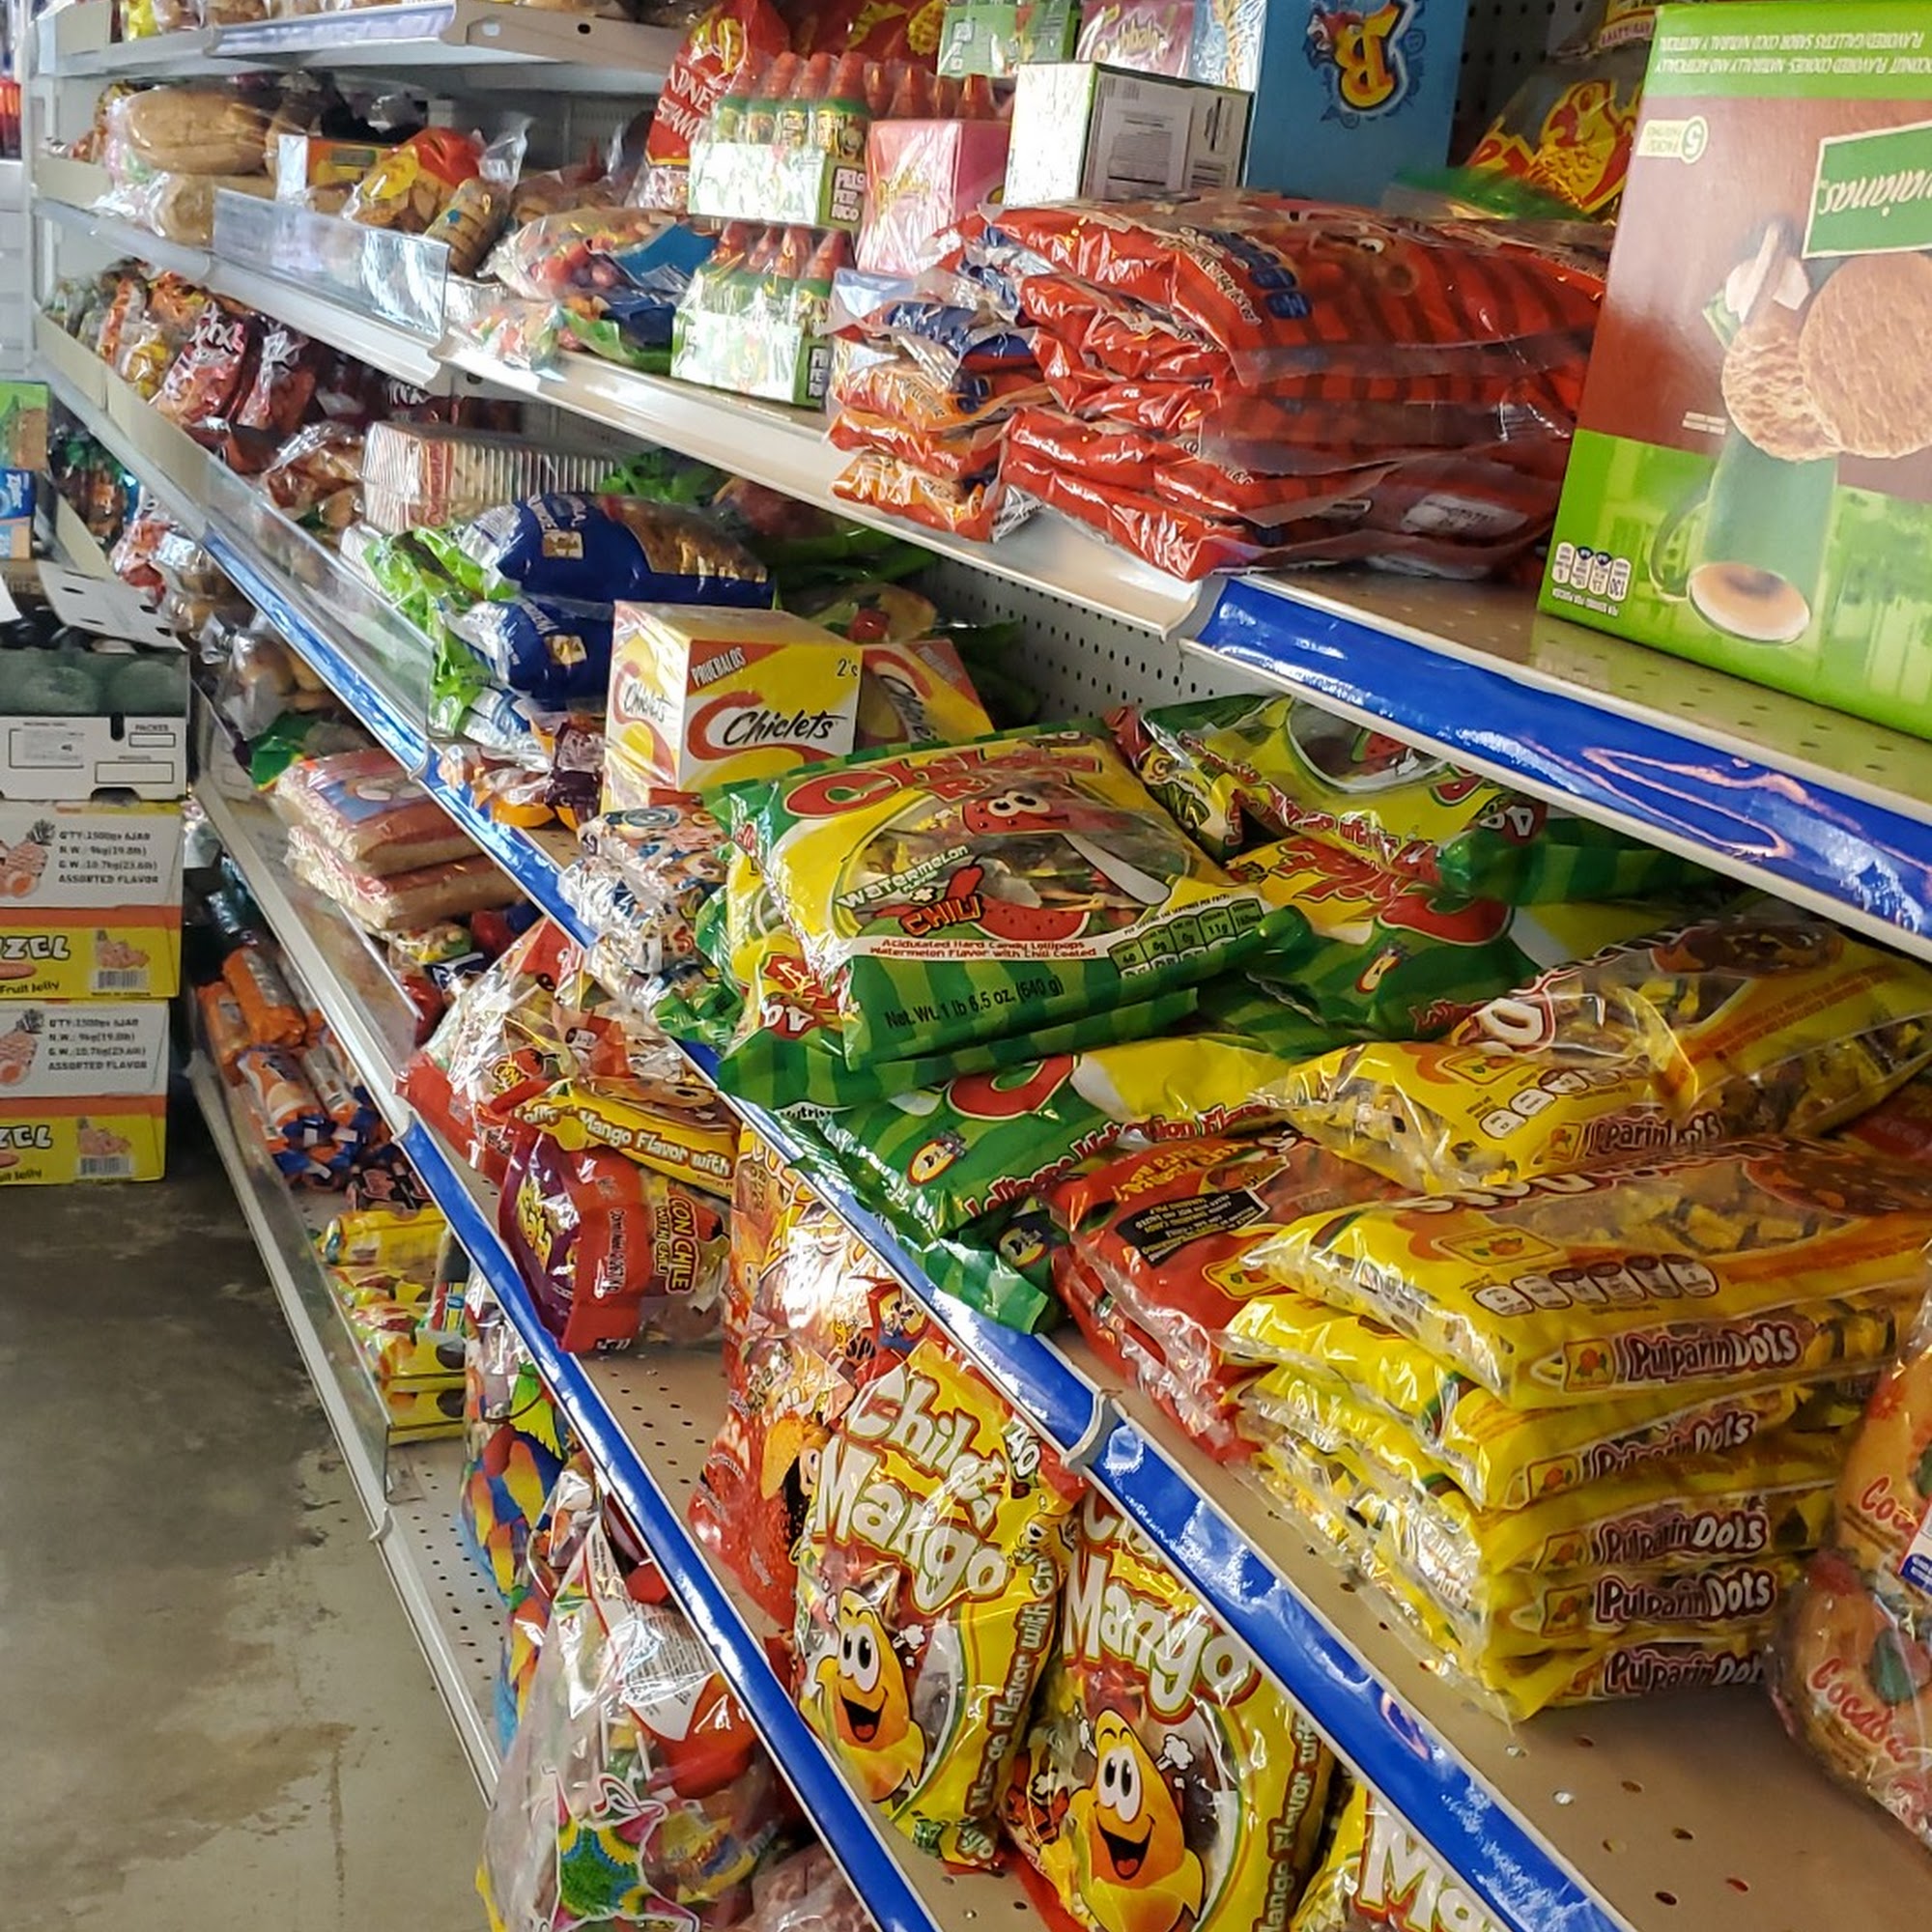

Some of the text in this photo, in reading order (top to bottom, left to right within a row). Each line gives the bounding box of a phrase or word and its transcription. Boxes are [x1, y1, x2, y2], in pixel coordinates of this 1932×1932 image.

[724, 709, 849, 747] Chiclets
[869, 947, 946, 958] Watermelon
[993, 948, 1021, 958] with
[1053, 948, 1097, 958] Coated
[580, 1109, 632, 1147] Mango
[636, 1132, 689, 1163] Flavor
[690, 1151, 731, 1177] with
[654, 1205, 671, 1241] WITH
[669, 1197, 698, 1293] CON CHILE
[814, 1434, 1009, 1612] Mango
[992, 1654, 1034, 1726] Flavor
[1020, 1603, 1052, 1649] with
[1063, 1547, 1253, 1713] Mango
[1605, 1649, 1762, 1692] PulparinDot
[1273, 1770, 1313, 1853] Flavor
